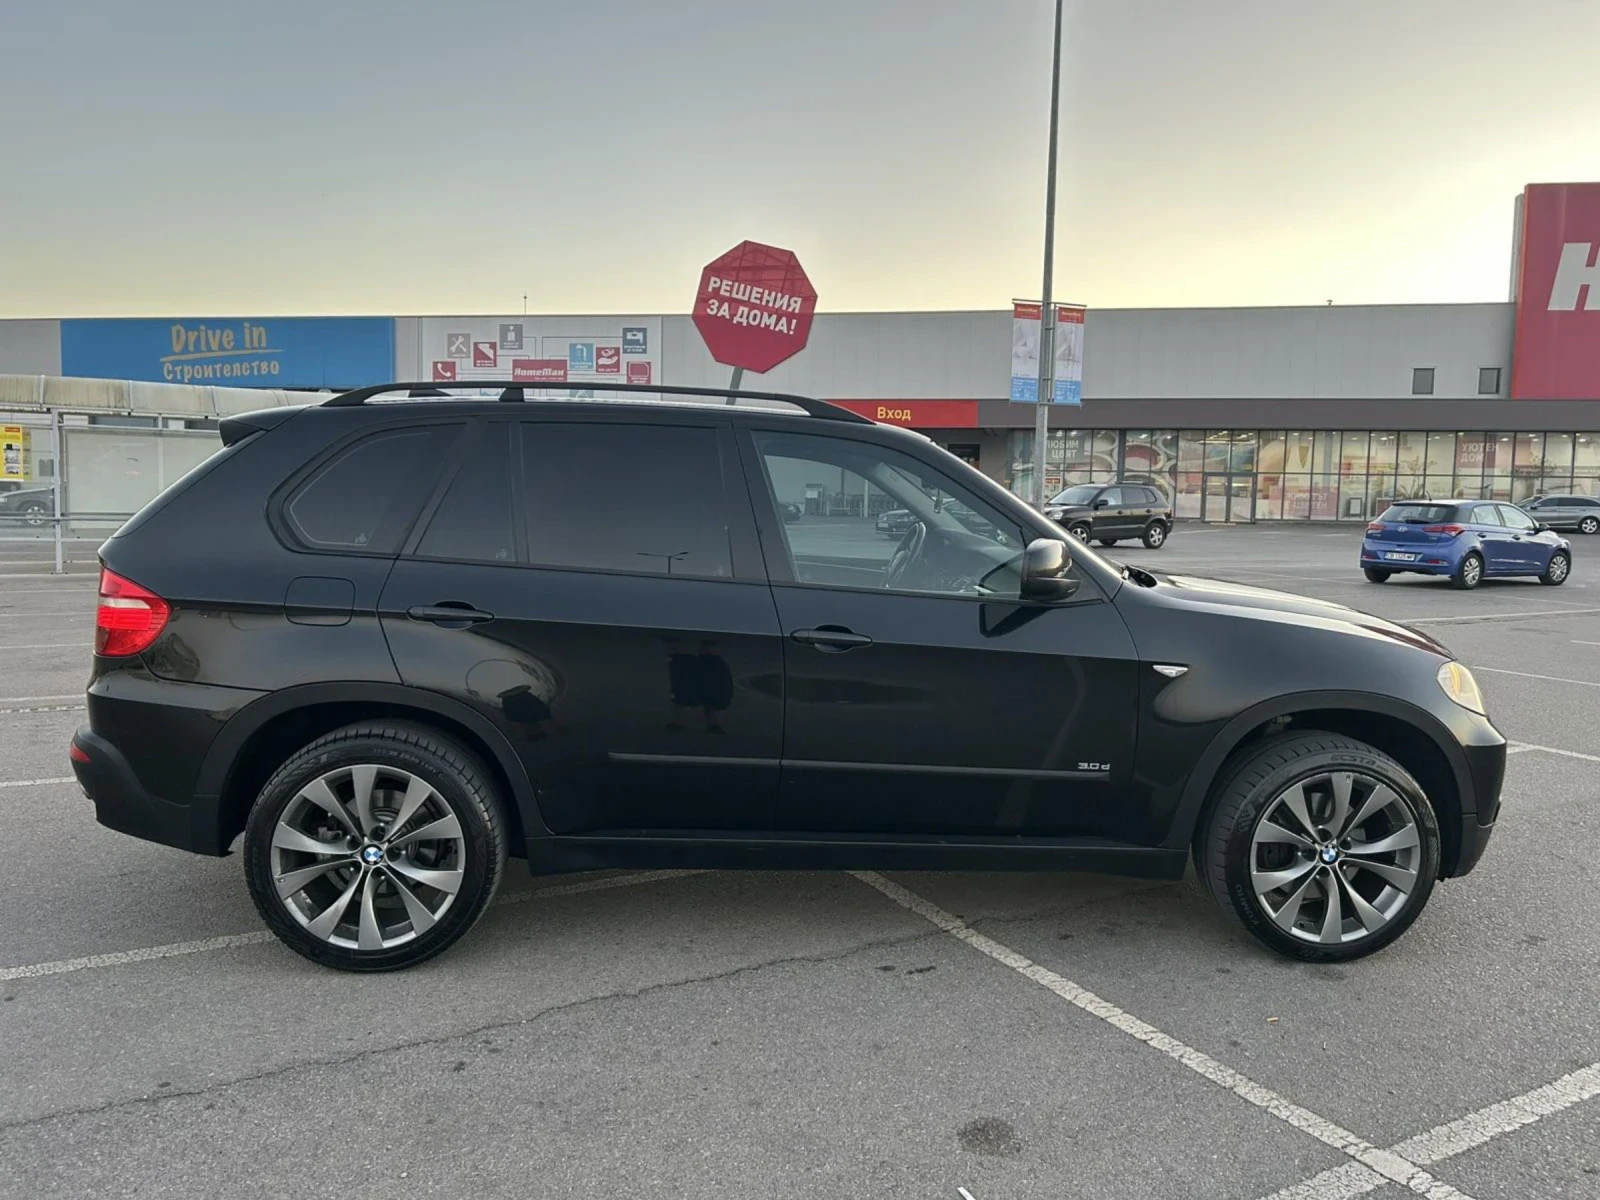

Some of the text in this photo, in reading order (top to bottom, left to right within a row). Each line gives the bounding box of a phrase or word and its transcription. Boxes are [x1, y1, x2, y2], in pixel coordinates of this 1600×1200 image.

[707, 276, 802, 313] РЕШЕНИЯ
[706, 299, 797, 335] ЗА ДОМА!
[171, 321, 267, 352] Drive in
[163, 361, 280, 383] Строителство
[514, 368, 564, 376] HomeMax
[877, 406, 911, 421] Вход
[1051, 449, 1077, 459] ЦВЯТ
[1462, 442, 1499, 452] УЮТЕН
[1460, 452, 1484, 463] ДОМ
